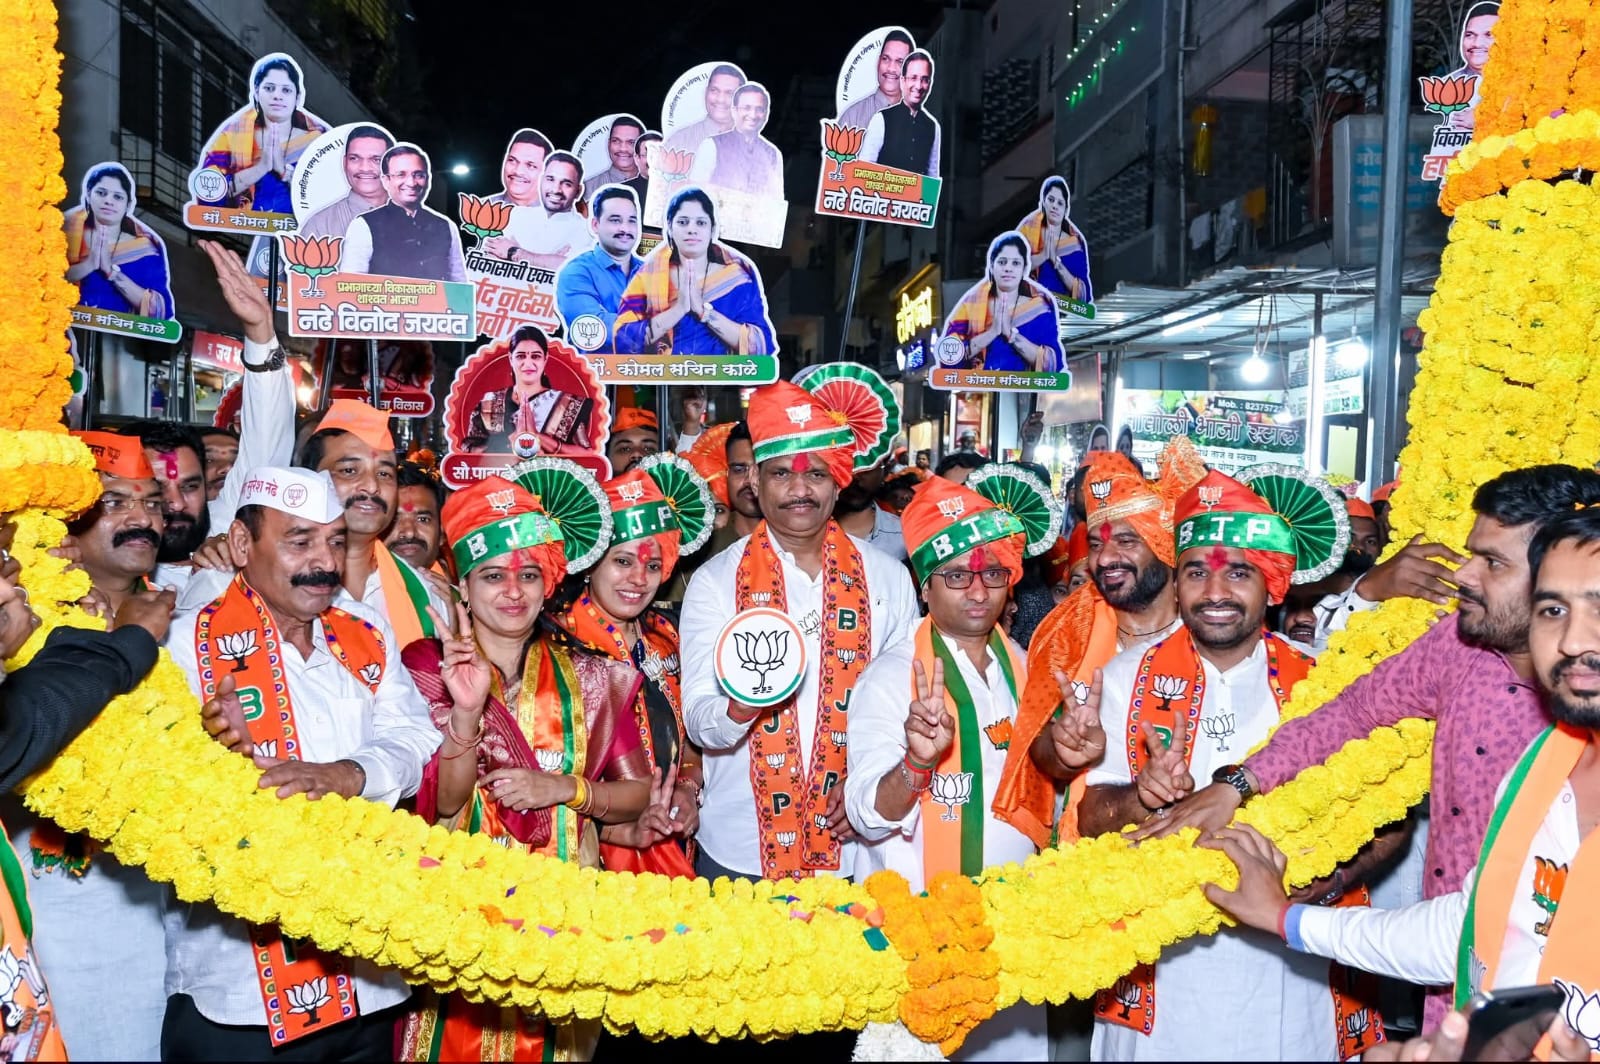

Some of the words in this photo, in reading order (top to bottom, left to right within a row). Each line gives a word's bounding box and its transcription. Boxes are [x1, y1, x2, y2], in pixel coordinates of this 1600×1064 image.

[824, 187, 848, 211] नढे
[849, 186, 890, 216] विनोद
[890, 198, 932, 222] जयवंत
[202, 210, 224, 224] सौ.
[230, 212, 268, 228] कोमल
[466, 252, 528, 281] विकासाची
[336, 280, 382, 294] प्रभागाच्या
[384, 280, 437, 295] विकासासाठी
[356, 294, 388, 304] शाश्वत
[389, 294, 418, 305] भाजपा
[96, 314, 134, 330] सचिन
[137, 320, 167, 334] काळे
[297, 304, 334, 332] नढे
[338, 302, 400, 334] विनोद
[403, 310, 468, 335] जयवंत
[617, 359, 664, 376] कोमल
[669, 359, 718, 376] सचिन
[722, 359, 758, 376] काळे
[944, 372, 960, 384] सौ.
[965, 372, 996, 386] कोमल
[999, 374, 1031, 386] सचिन
[1034, 376, 1058, 387] काळे
[393, 398, 424, 411] विलास
[1218, 400, 1238, 408] Mob.
[1196, 412, 1242, 442] भाजी
